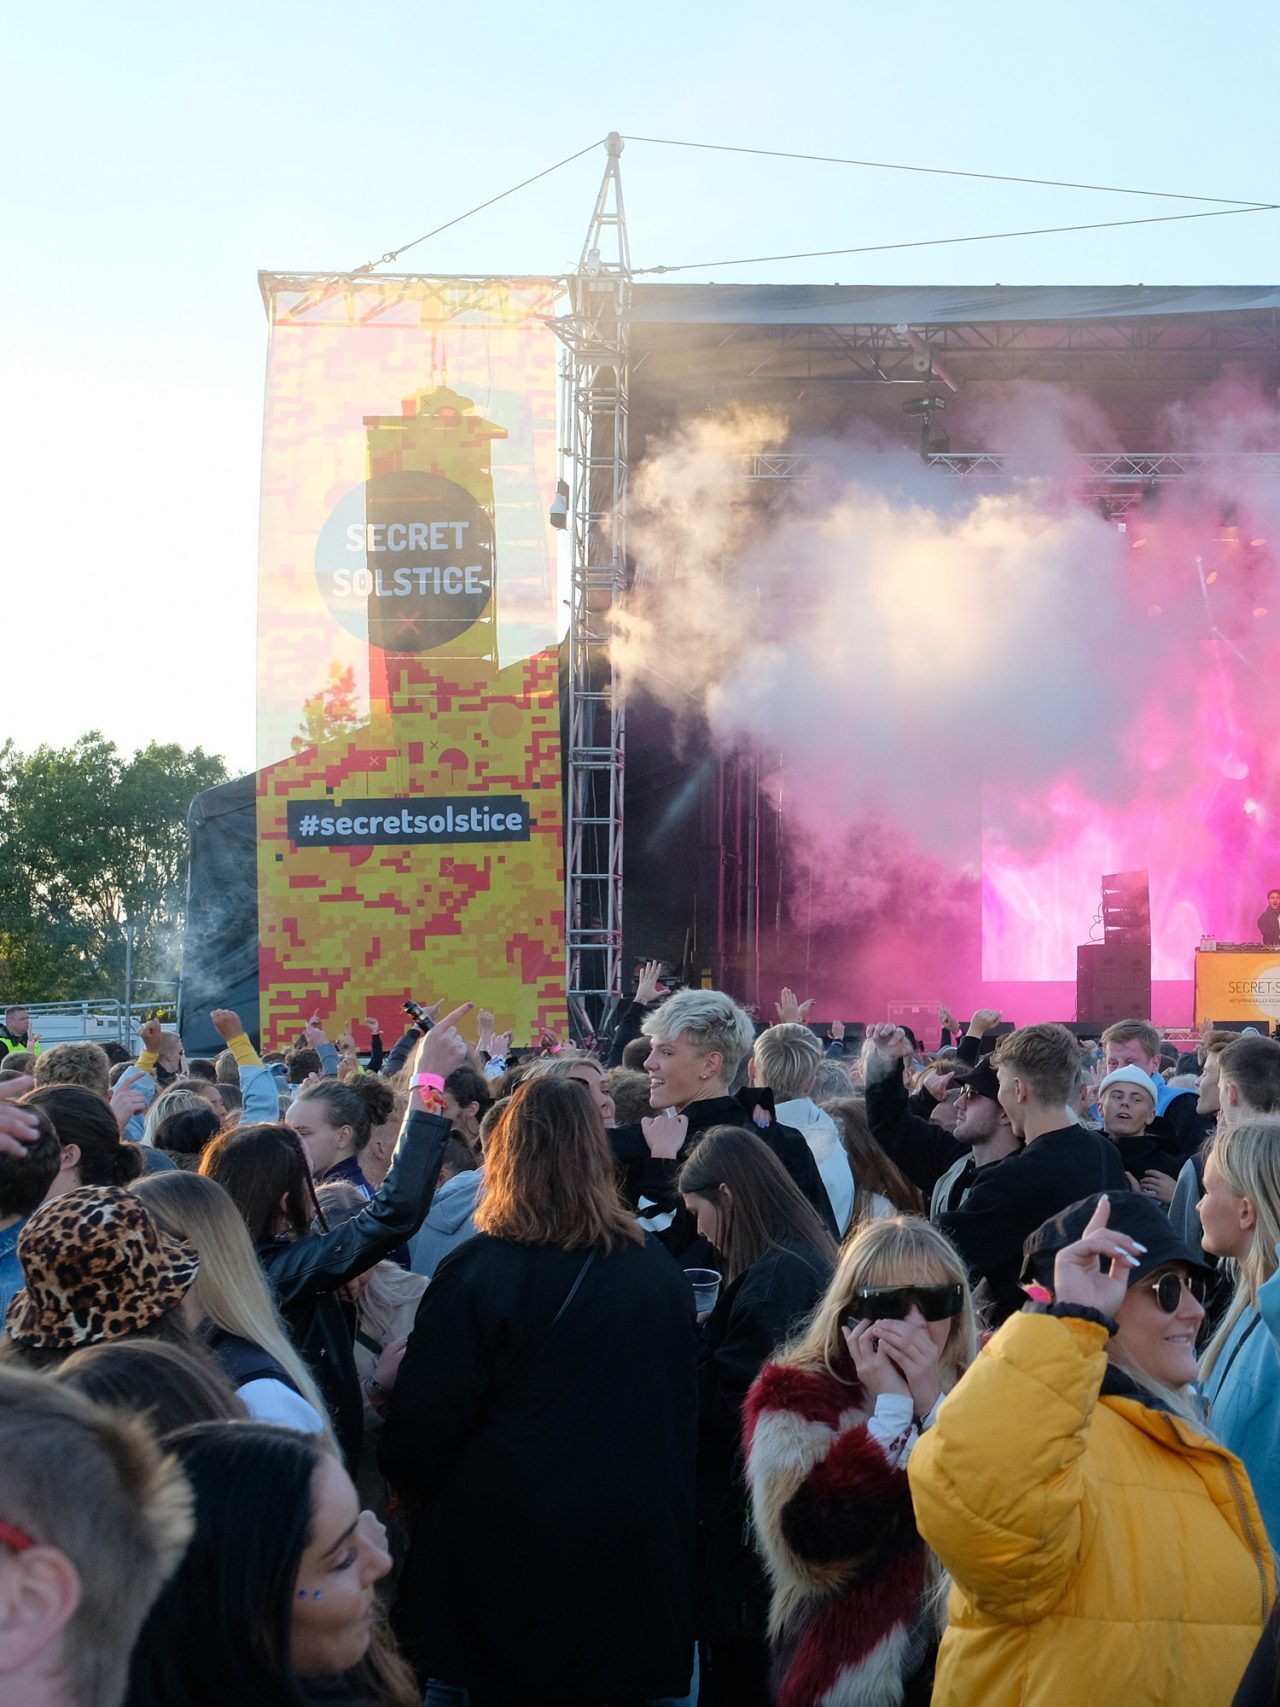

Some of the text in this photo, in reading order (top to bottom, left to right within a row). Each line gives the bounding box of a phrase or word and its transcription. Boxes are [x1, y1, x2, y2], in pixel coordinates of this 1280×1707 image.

[346, 522, 470, 552] SECRET
[332, 565, 483, 597] SOLSTICE
[298, 805, 523, 836] #secretsolstice
[1228, 981, 1272, 994] SECRET
